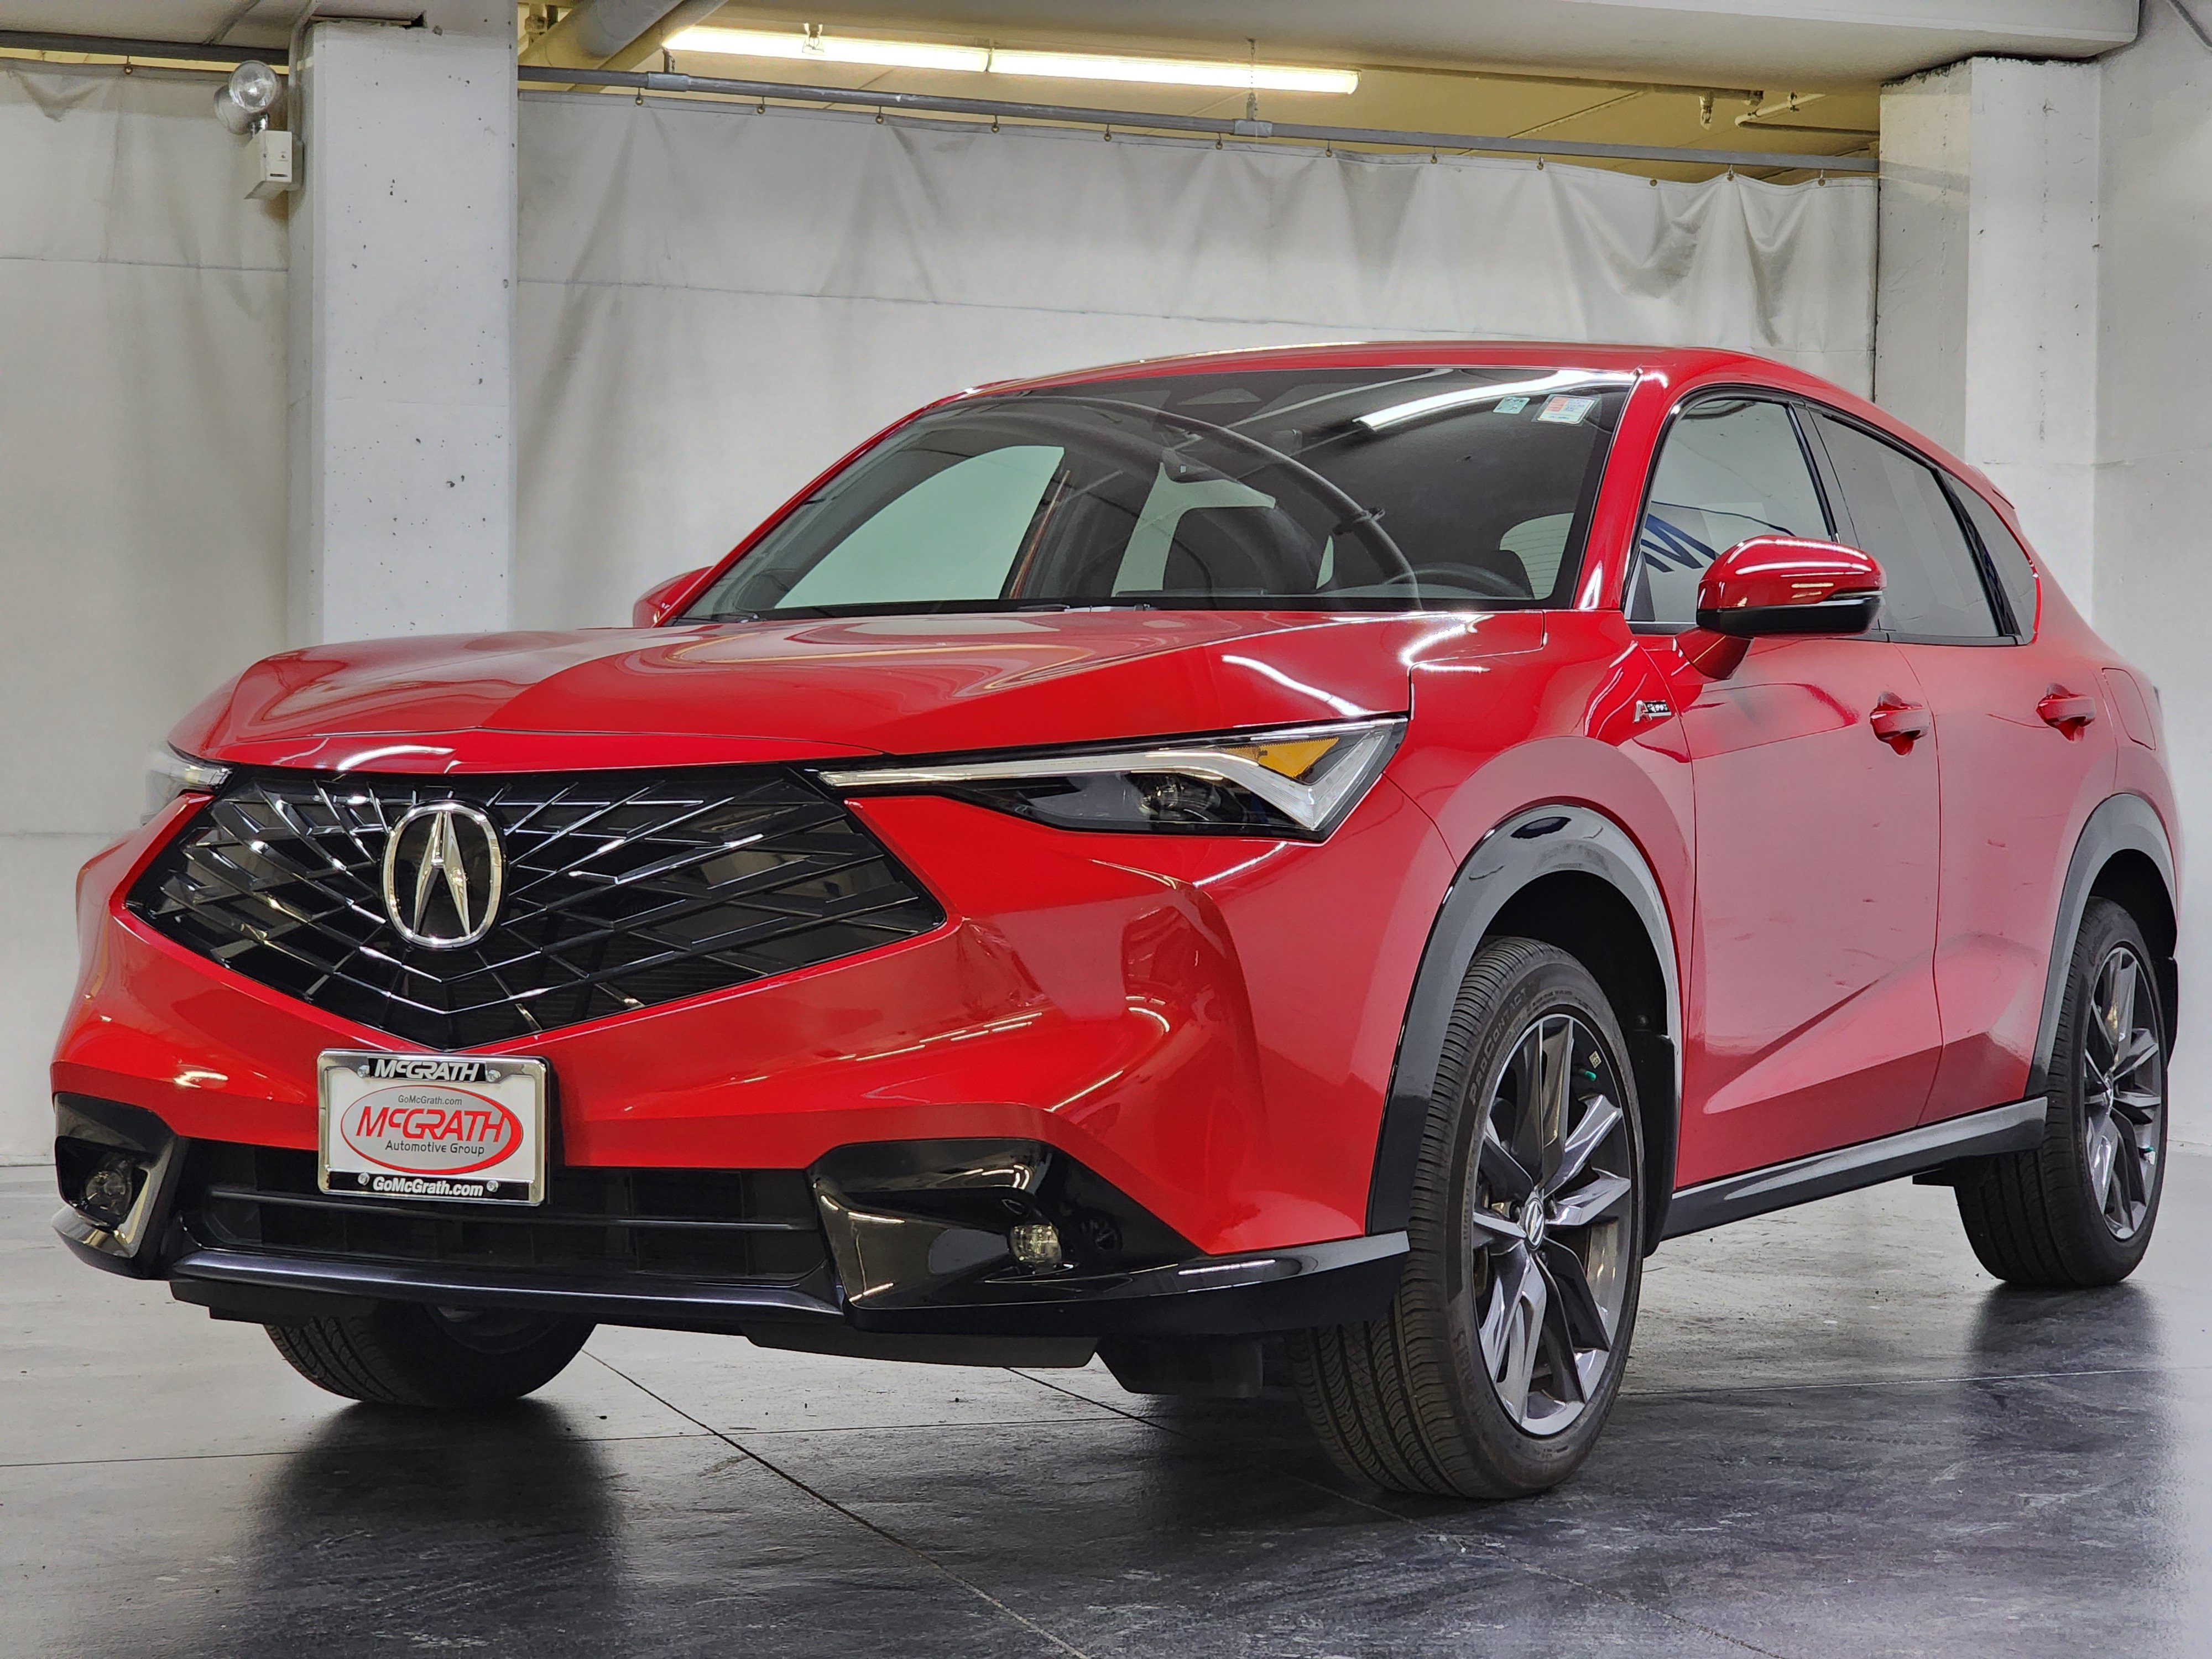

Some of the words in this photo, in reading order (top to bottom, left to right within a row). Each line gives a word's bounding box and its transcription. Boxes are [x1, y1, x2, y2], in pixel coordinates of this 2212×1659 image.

[398, 1094, 462, 1105] GoMcGrath.com
[385, 1140, 447, 1153] Automotive
[450, 1142, 484, 1157] Group
[373, 1176, 484, 1197] GoMcGrath.com
